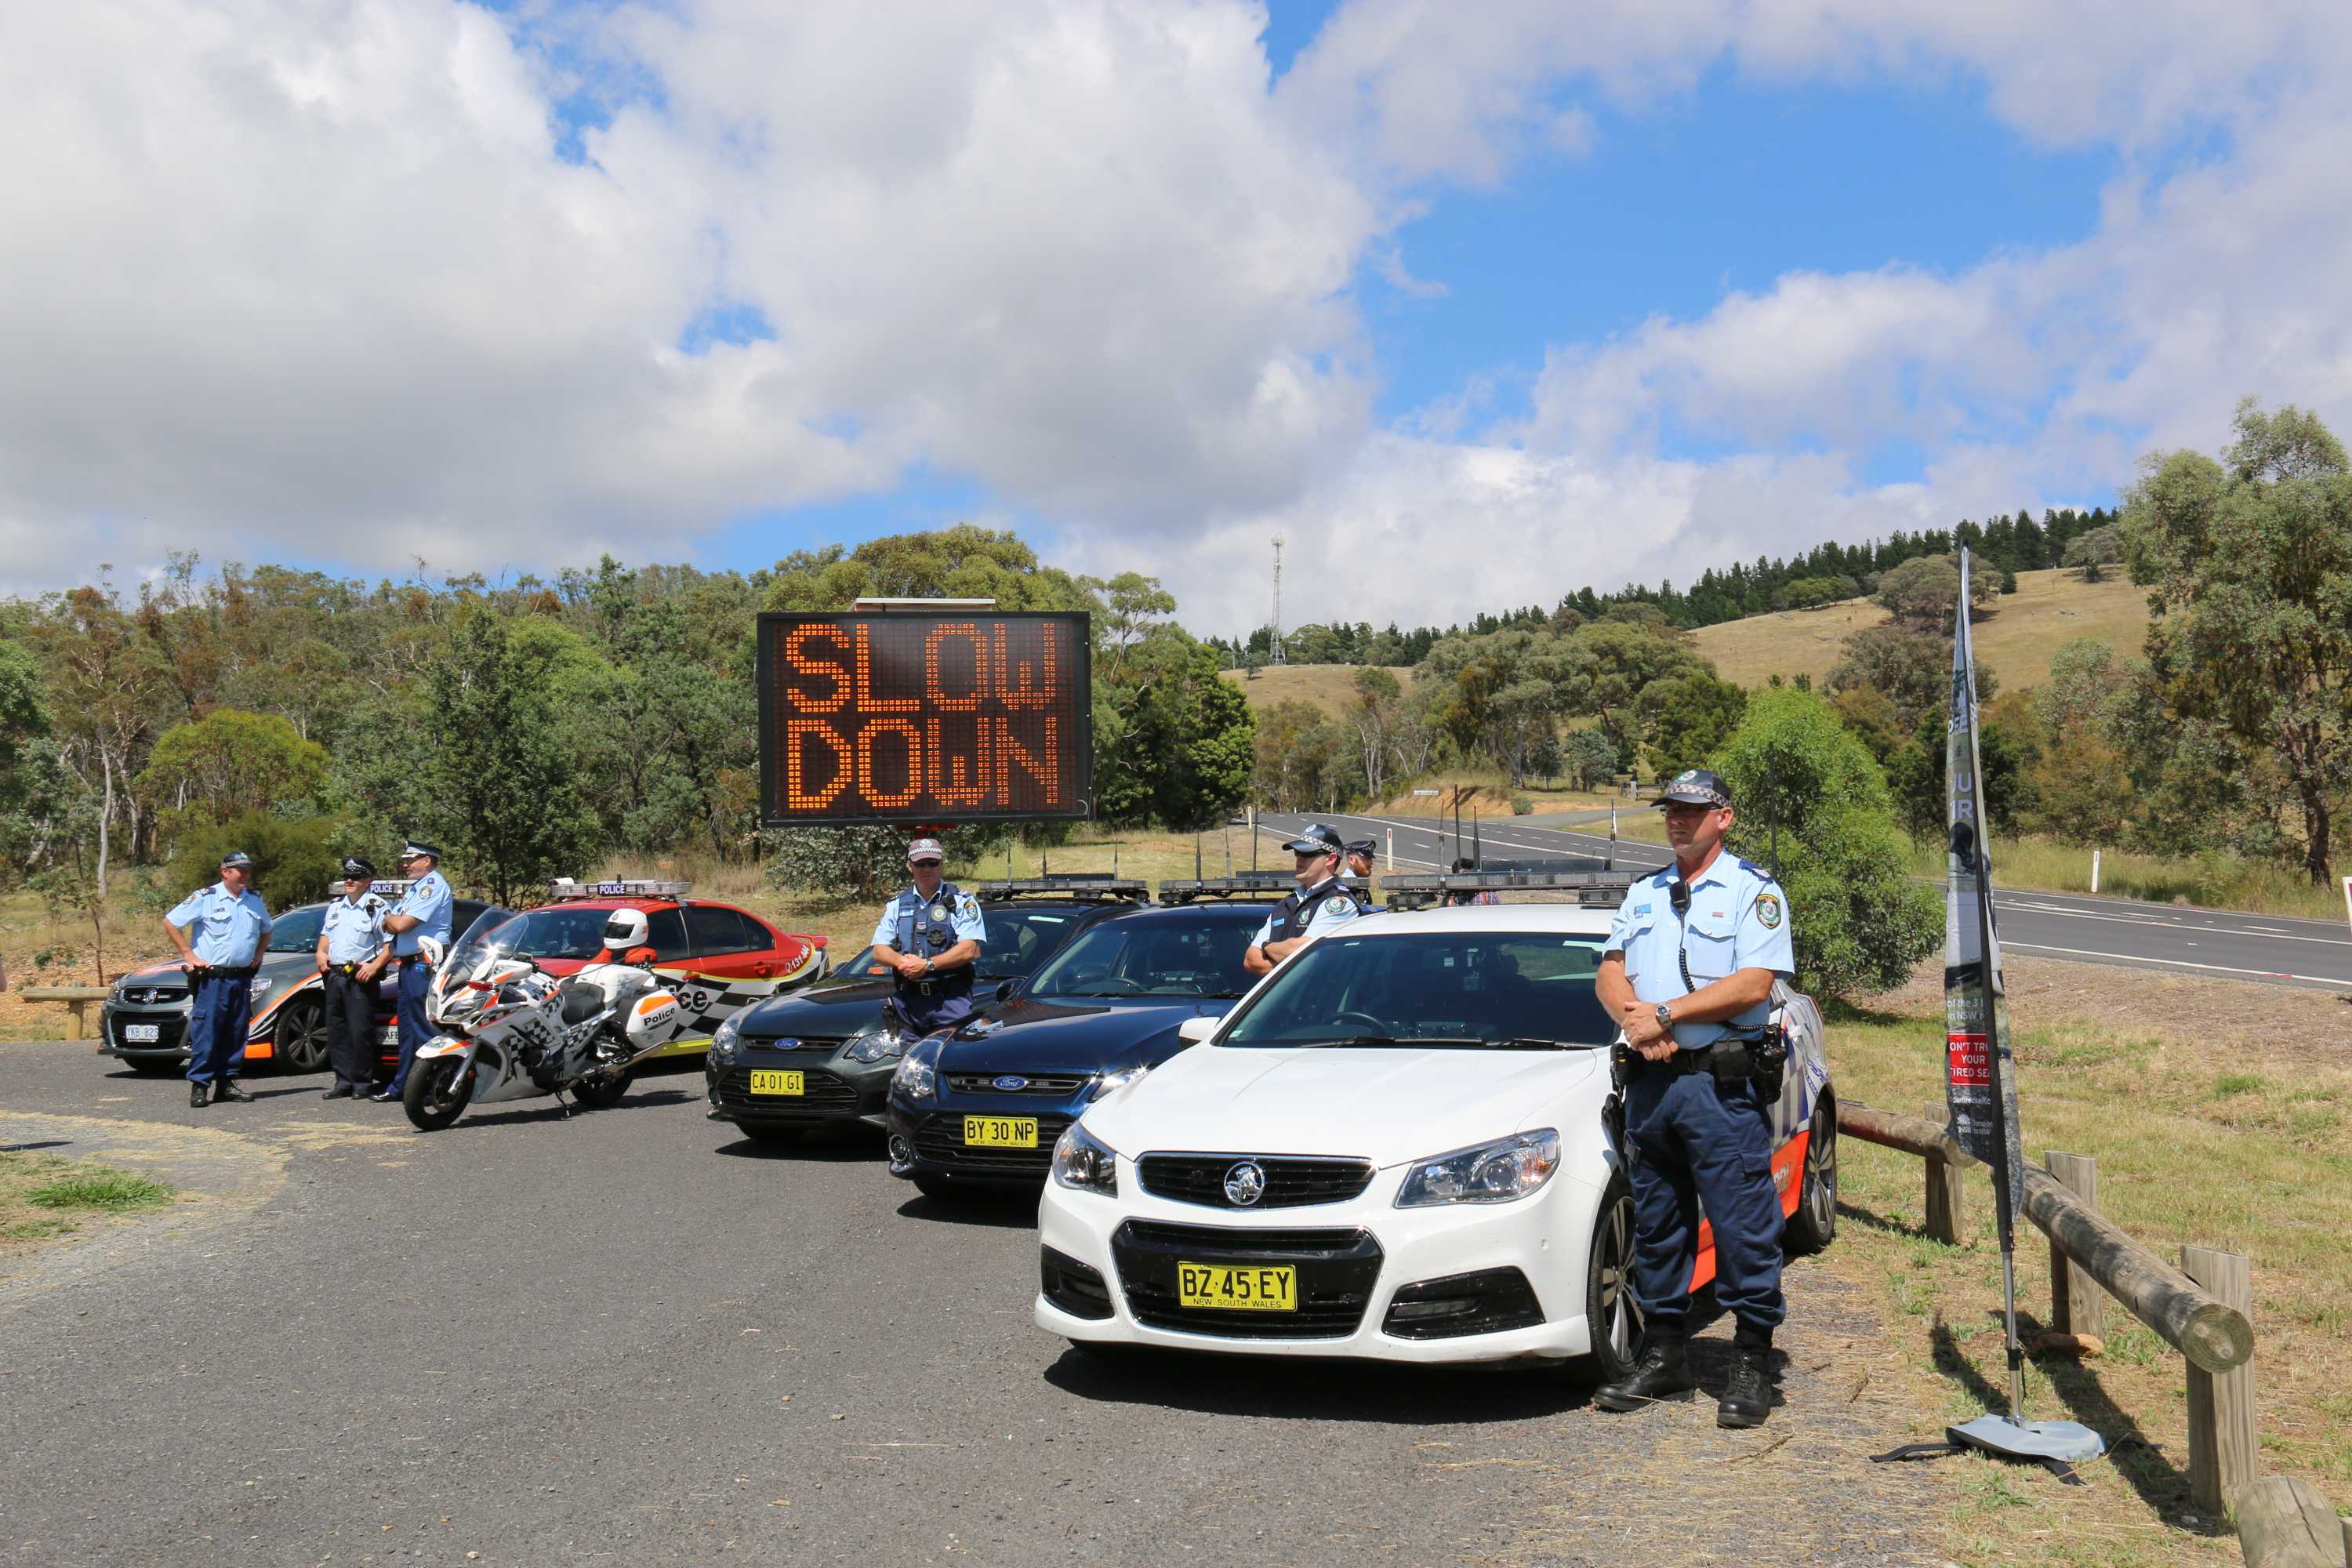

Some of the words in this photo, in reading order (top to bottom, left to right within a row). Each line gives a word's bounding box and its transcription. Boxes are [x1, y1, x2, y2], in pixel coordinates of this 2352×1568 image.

[786, 623, 1055, 713] SLOW
[788, 717, 1058, 808] DOWN
[599, 885, 626, 894] POLICE
[643, 1006, 676, 1026] Police
[1961, 1054, 1986, 1065] YOUR
[1193, 1298, 1213, 1306] NEW
[1217, 1298, 1248, 1308] SOUTH
[1252, 1300, 1282, 1308] WALES
